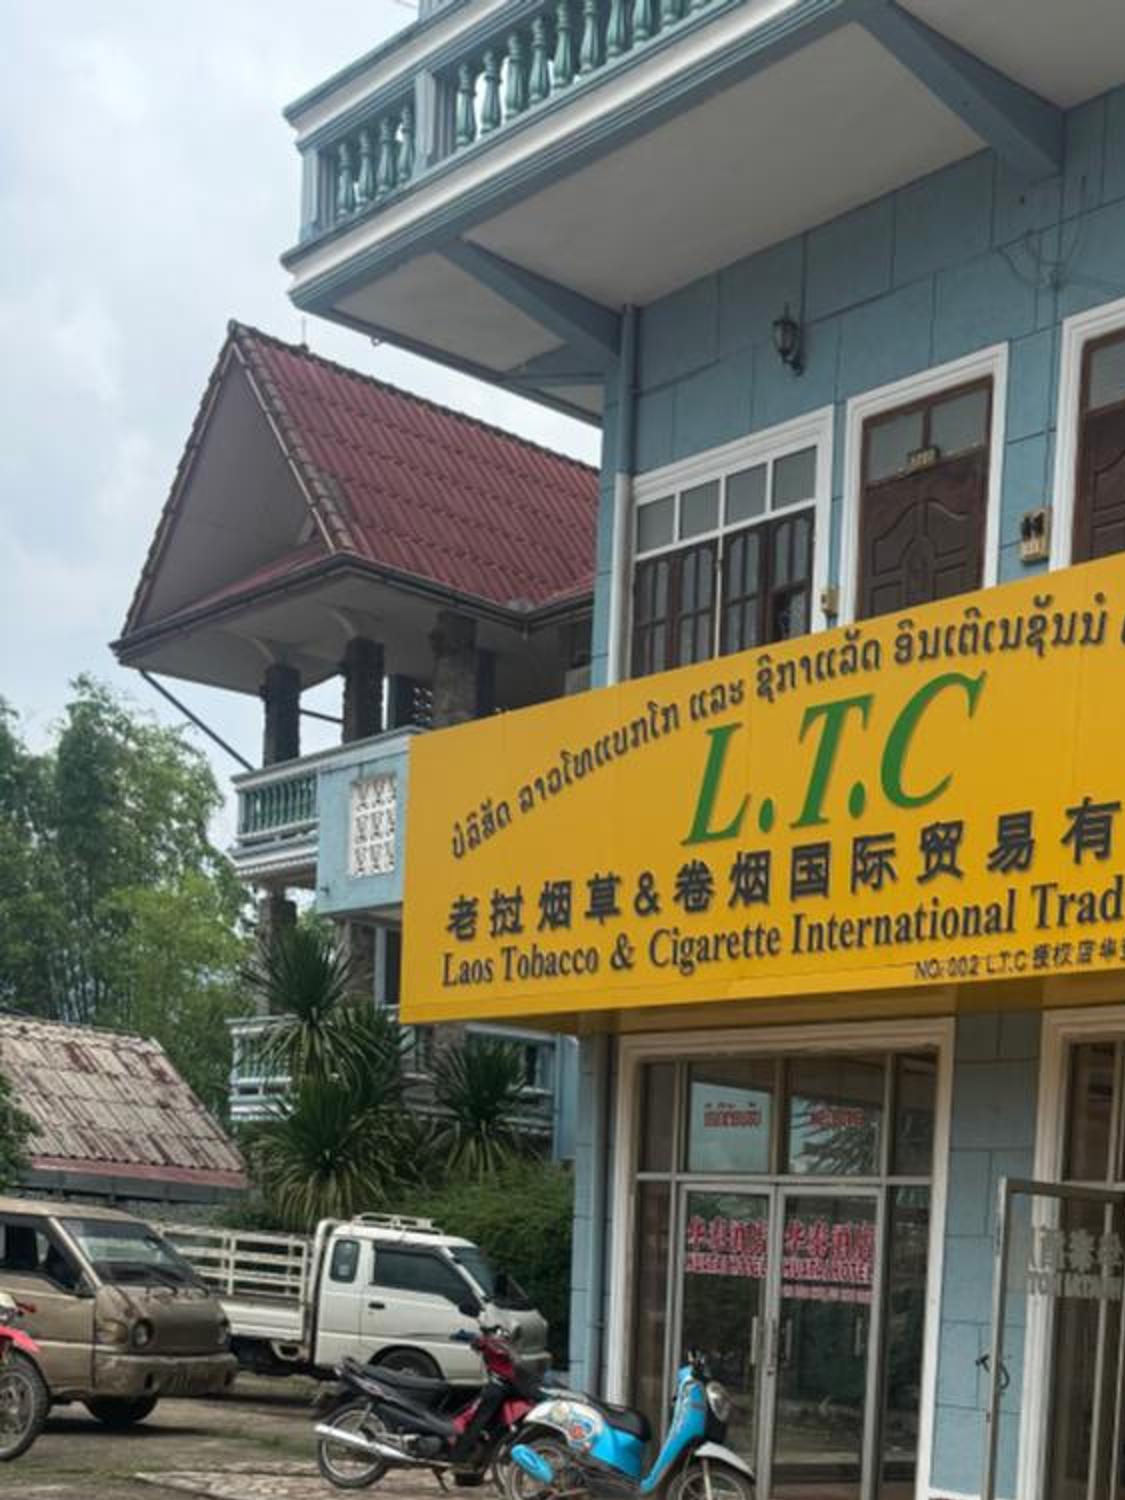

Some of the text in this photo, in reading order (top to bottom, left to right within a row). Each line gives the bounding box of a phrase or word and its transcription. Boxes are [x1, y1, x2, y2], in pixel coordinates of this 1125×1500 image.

[688, 679, 746, 722] ແລະ
[679, 669, 987, 848] L.T.C
[442, 951, 495, 988] Laos
[499, 943, 600, 983] Tobacco
[609, 932, 636, 971] &
[648, 923, 781, 977] Cigarette
[791, 888, 1017, 955] International
